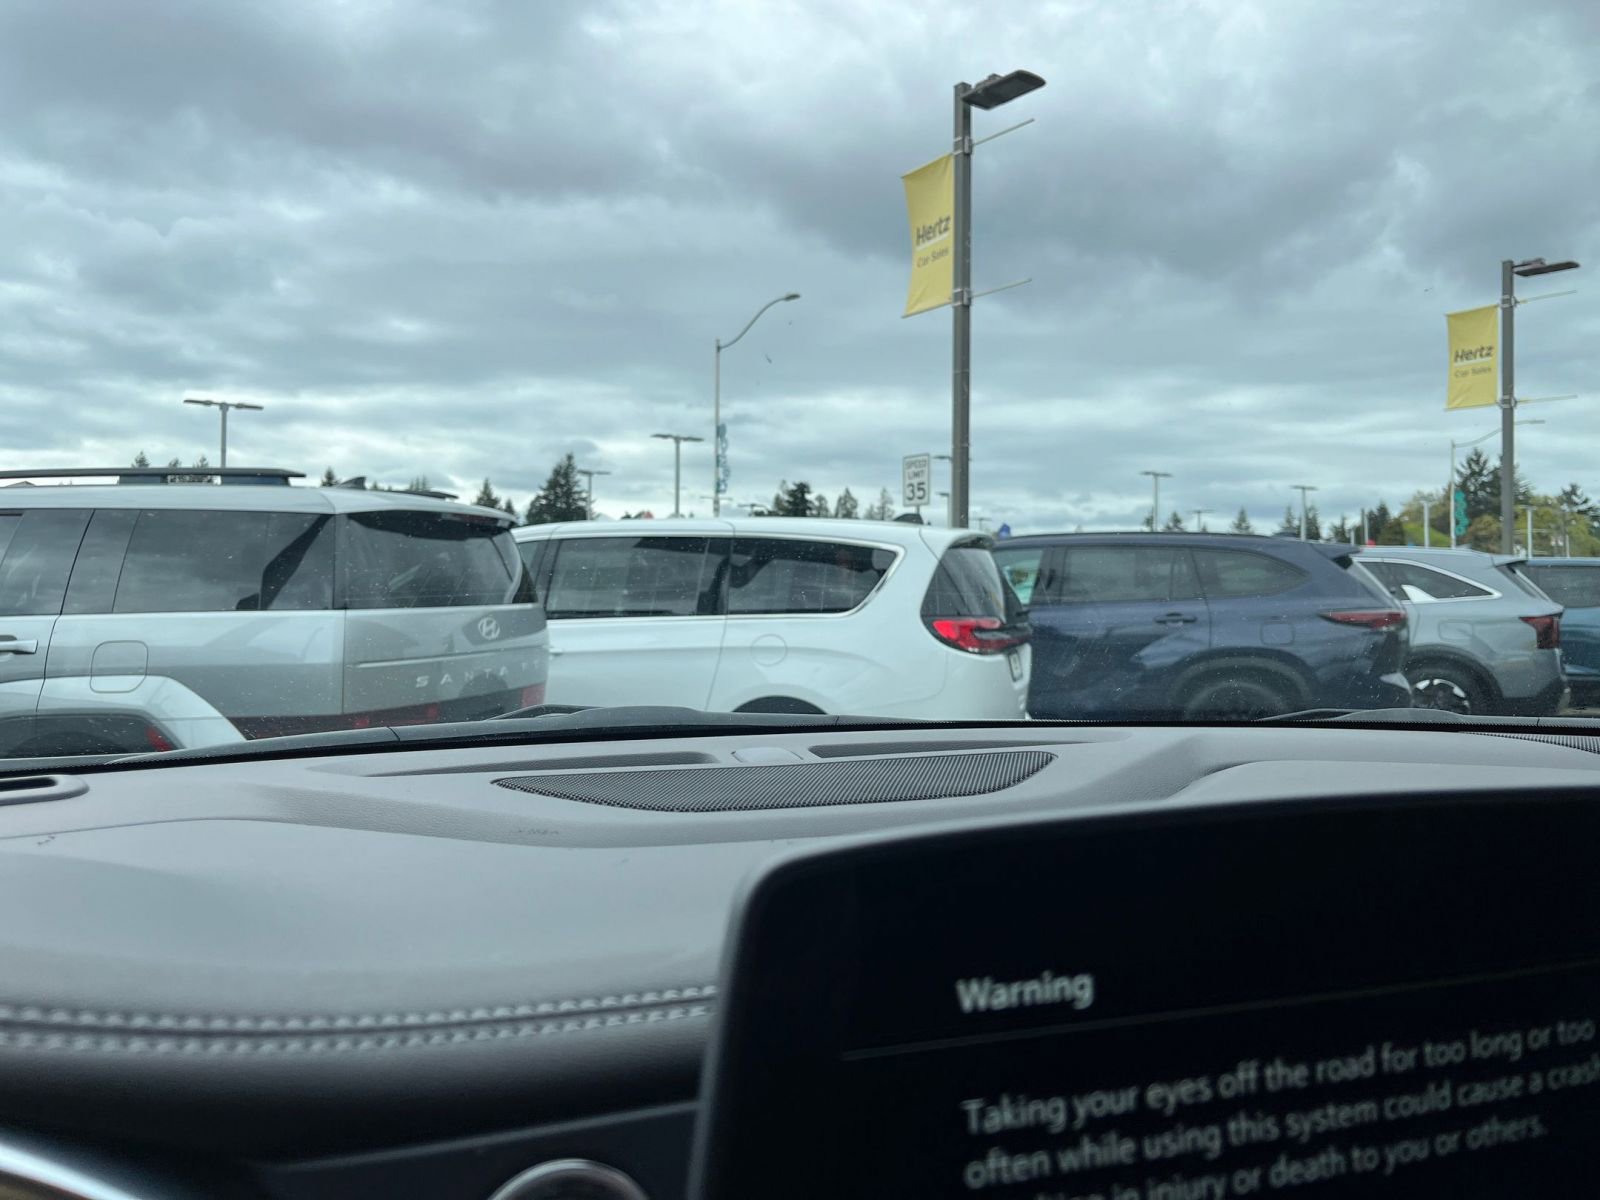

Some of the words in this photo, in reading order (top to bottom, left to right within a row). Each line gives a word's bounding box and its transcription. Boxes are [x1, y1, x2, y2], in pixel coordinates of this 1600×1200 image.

[916, 214, 951, 247] Hertz
[916, 255, 930, 268] Car
[1454, 345, 1494, 363] Hertz
[905, 459, 927, 470] SPEED
[907, 470, 925, 480] LIMIT
[906, 482, 926, 501] 35
[416, 665, 509, 688] SANTA
[957, 972, 1094, 1012] Warning
[961, 1093, 1066, 1134] Taking
[1071, 1086, 1139, 1130] your
[1145, 1077, 1213, 1116] eyes
[1217, 1059, 1259, 1099] off
[1264, 1057, 1309, 1092] the
[1316, 1044, 1375, 1082] road
[1381, 1041, 1417, 1072] for
[1424, 1039, 1465, 1067] too
[1470, 1029, 1523, 1062] long
[1527, 1026, 1551, 1050] or
[1557, 1019, 1595, 1045] too
[963, 1147, 1050, 1189] often
[1057, 1130, 1136, 1172] while
[1143, 1122, 1222, 1160] using
[1228, 1110, 1280, 1145] this
[1285, 1100, 1379, 1143] system
[1384, 1079, 1451, 1120] could
[1457, 1075, 1524, 1107] cause
[1528, 1071, 1543, 1094] a
[1232, 1166, 1262, 1195] or
[1269, 1153, 1347, 1188] death
[1352, 1146, 1380, 1173] to
[1384, 1138, 1430, 1176] you
[1435, 1131, 1462, 1156] or
[1466, 1116, 1548, 1150] others.
